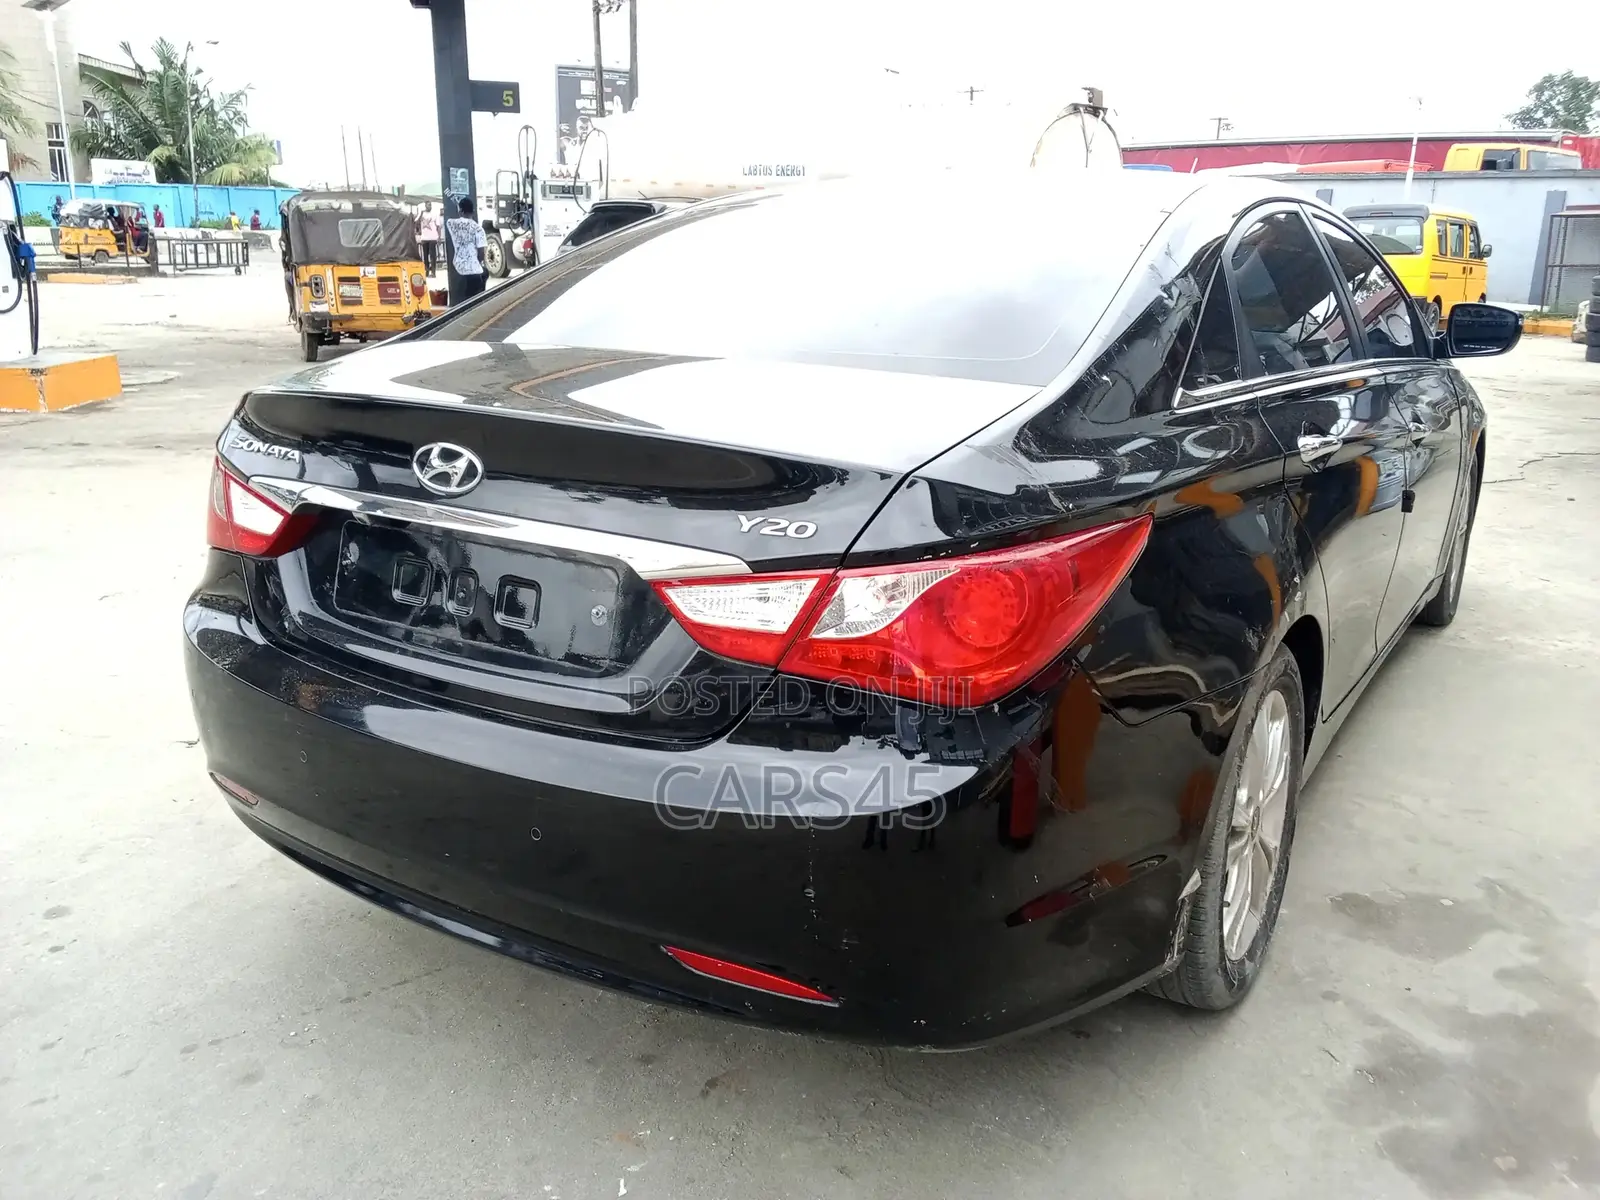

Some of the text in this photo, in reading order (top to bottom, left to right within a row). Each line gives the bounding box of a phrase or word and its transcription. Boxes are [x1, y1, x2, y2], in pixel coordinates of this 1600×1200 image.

[502, 90, 513, 107] 5
[230, 437, 301, 463] SONATA
[737, 514, 818, 539] Y20
